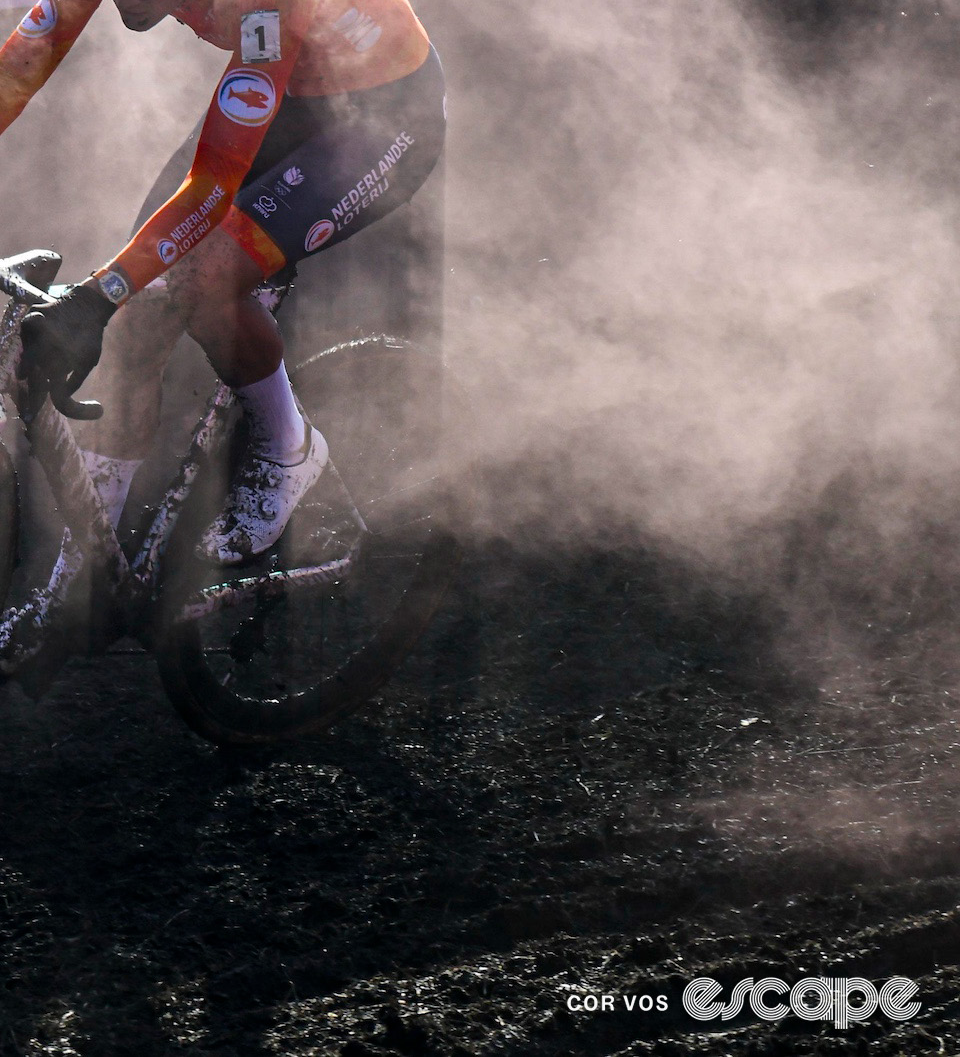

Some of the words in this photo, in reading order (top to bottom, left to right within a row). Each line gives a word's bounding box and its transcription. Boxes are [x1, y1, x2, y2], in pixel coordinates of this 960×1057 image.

[254, 26, 267, 52] 1
[330, 130, 415, 221] NEDERLANDSE
[170, 184, 226, 243] NEDERLANDSE
[337, 179, 390, 231] LOTERIJ
[178, 218, 211, 254] LOTERIJ
